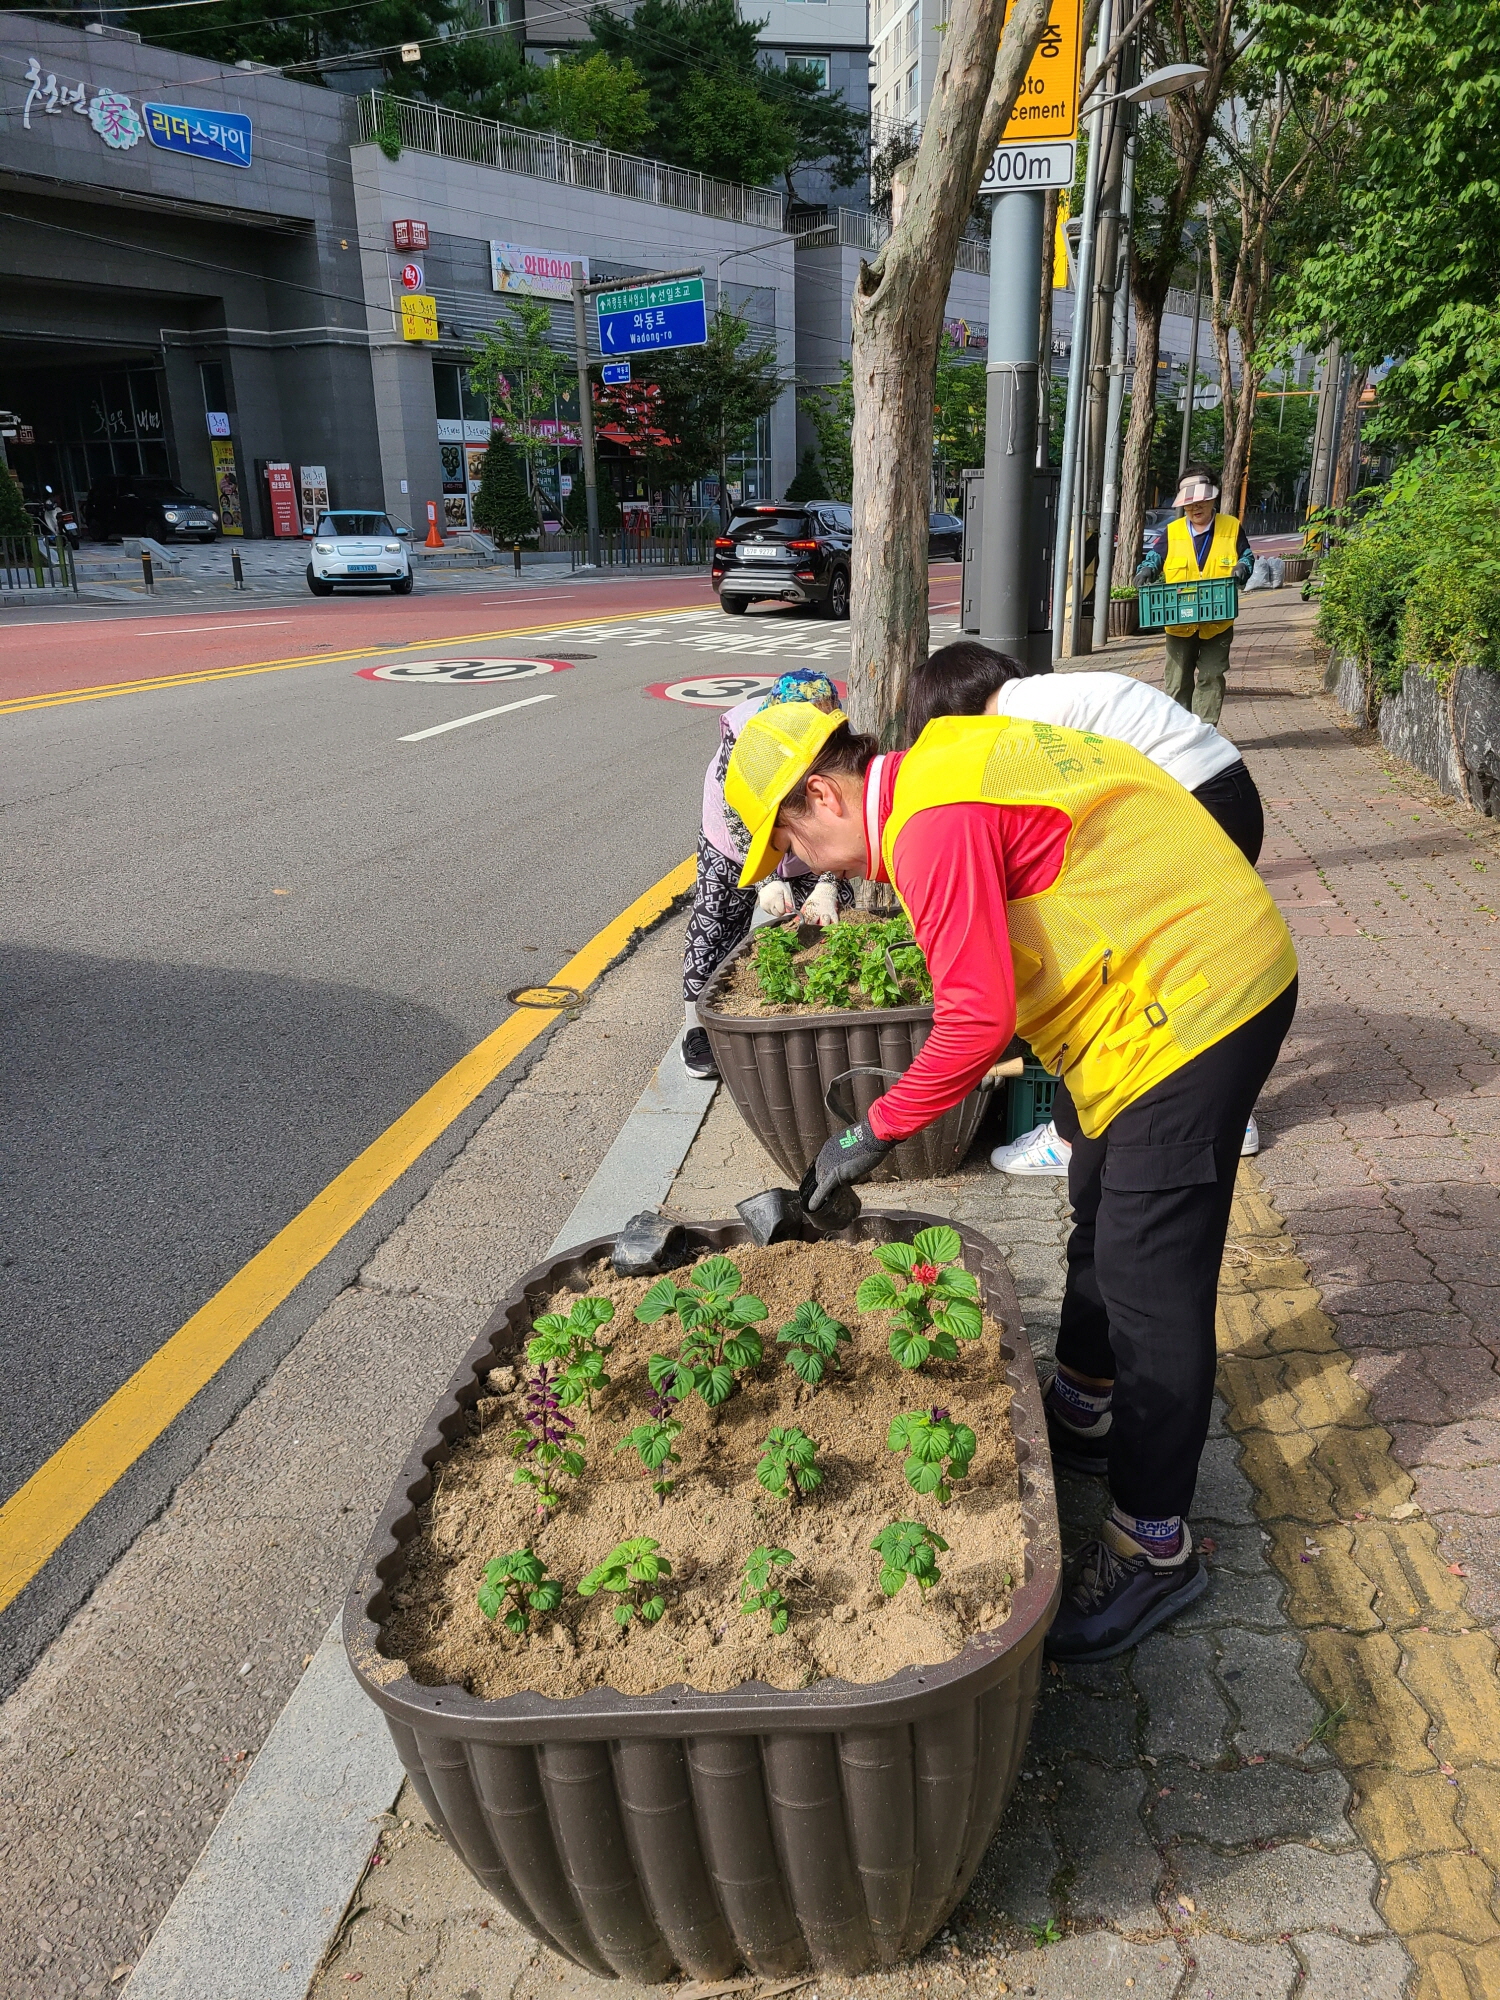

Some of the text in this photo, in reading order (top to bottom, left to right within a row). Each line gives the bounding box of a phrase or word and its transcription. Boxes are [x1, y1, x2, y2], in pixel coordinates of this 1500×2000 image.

[1011, 101, 1066, 120] cement
[152, 112, 246, 154] 리더스카이
[658, 285, 691, 303] 선일초교
[633, 310, 666, 331] 와동로
[629, 331, 673, 344] Wadong-ro
[389, 661, 538, 680] 30
[681, 679, 775, 700] 3
[1136, 1520, 1169, 1529] RAIN
